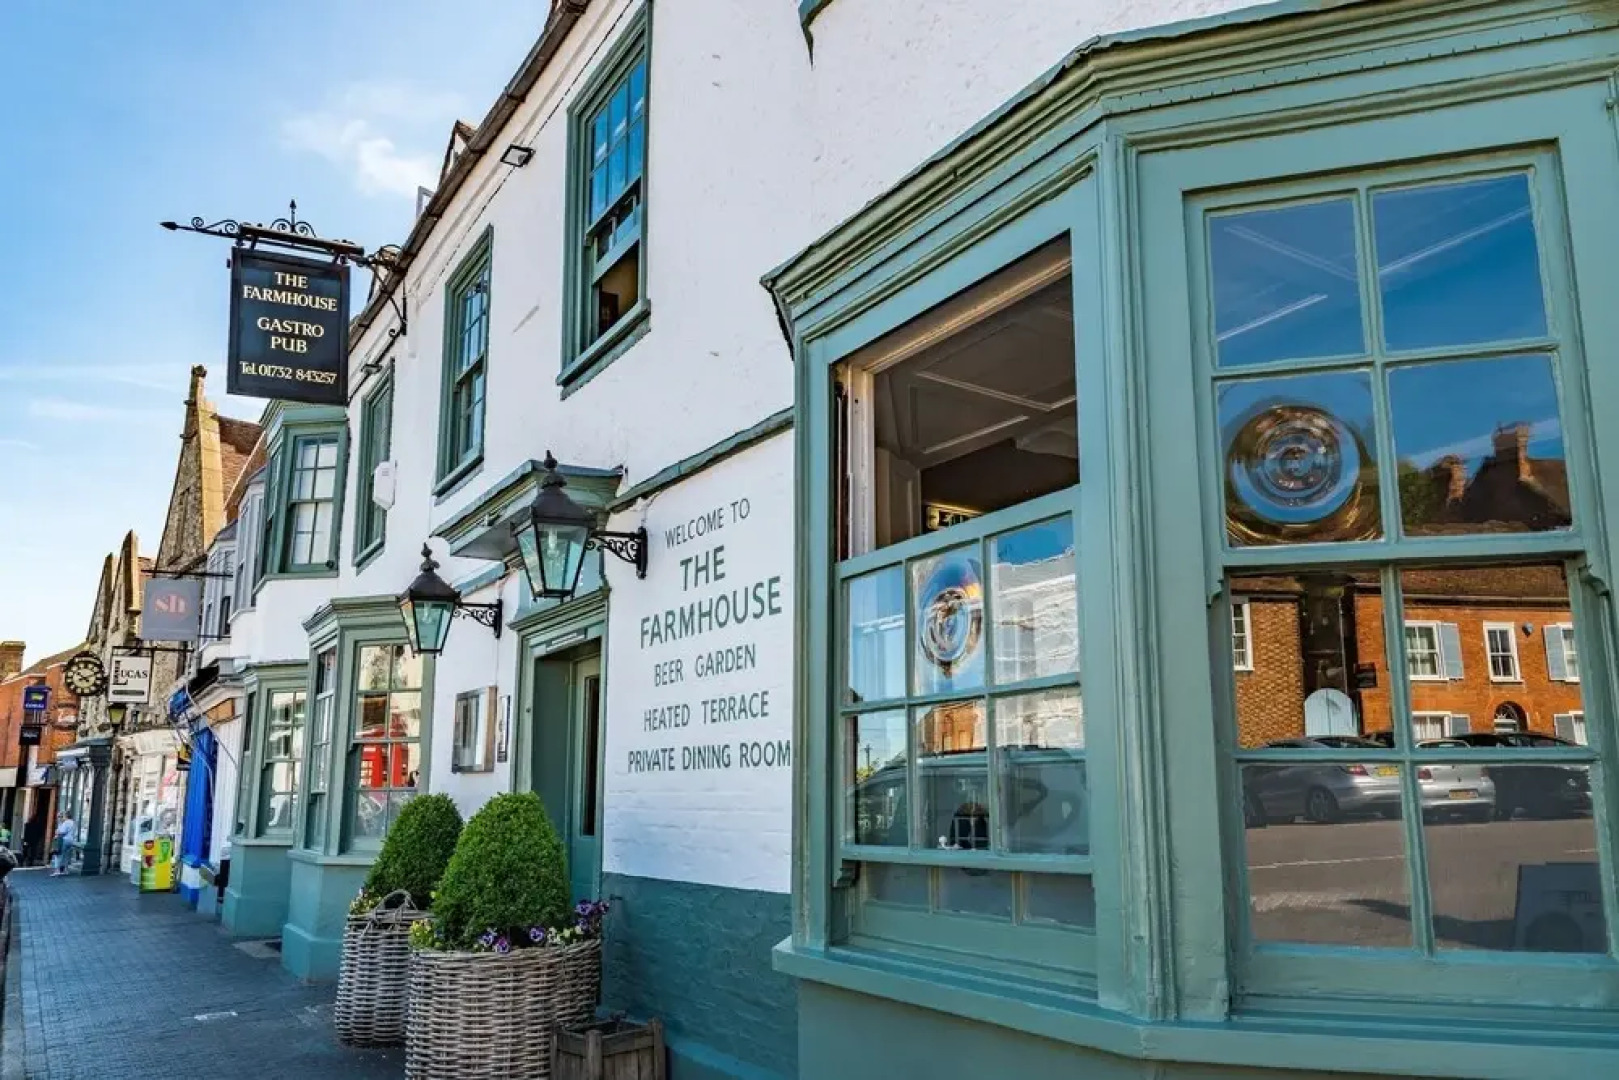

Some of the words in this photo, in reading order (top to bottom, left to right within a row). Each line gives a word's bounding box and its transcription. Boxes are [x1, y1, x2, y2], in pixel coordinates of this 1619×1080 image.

[243, 285, 337, 311] FARMHOUSE
[275, 272, 308, 289] THE
[257, 317, 324, 337] GASTRO
[271, 336, 307, 353] PUB
[665, 507, 724, 549] WELCOME
[730, 498, 750, 524] TO
[680, 545, 726, 591] THE
[640, 576, 782, 649] FARMHOUSE
[654, 658, 683, 687] BEER
[695, 643, 755, 678] GARDEN
[643, 703, 690, 732] HEATED
[701, 690, 769, 725] TERRACE
[628, 747, 675, 774] PRIVATE
[682, 744, 731, 771] DINING
[739, 740, 791, 768] ROOM
